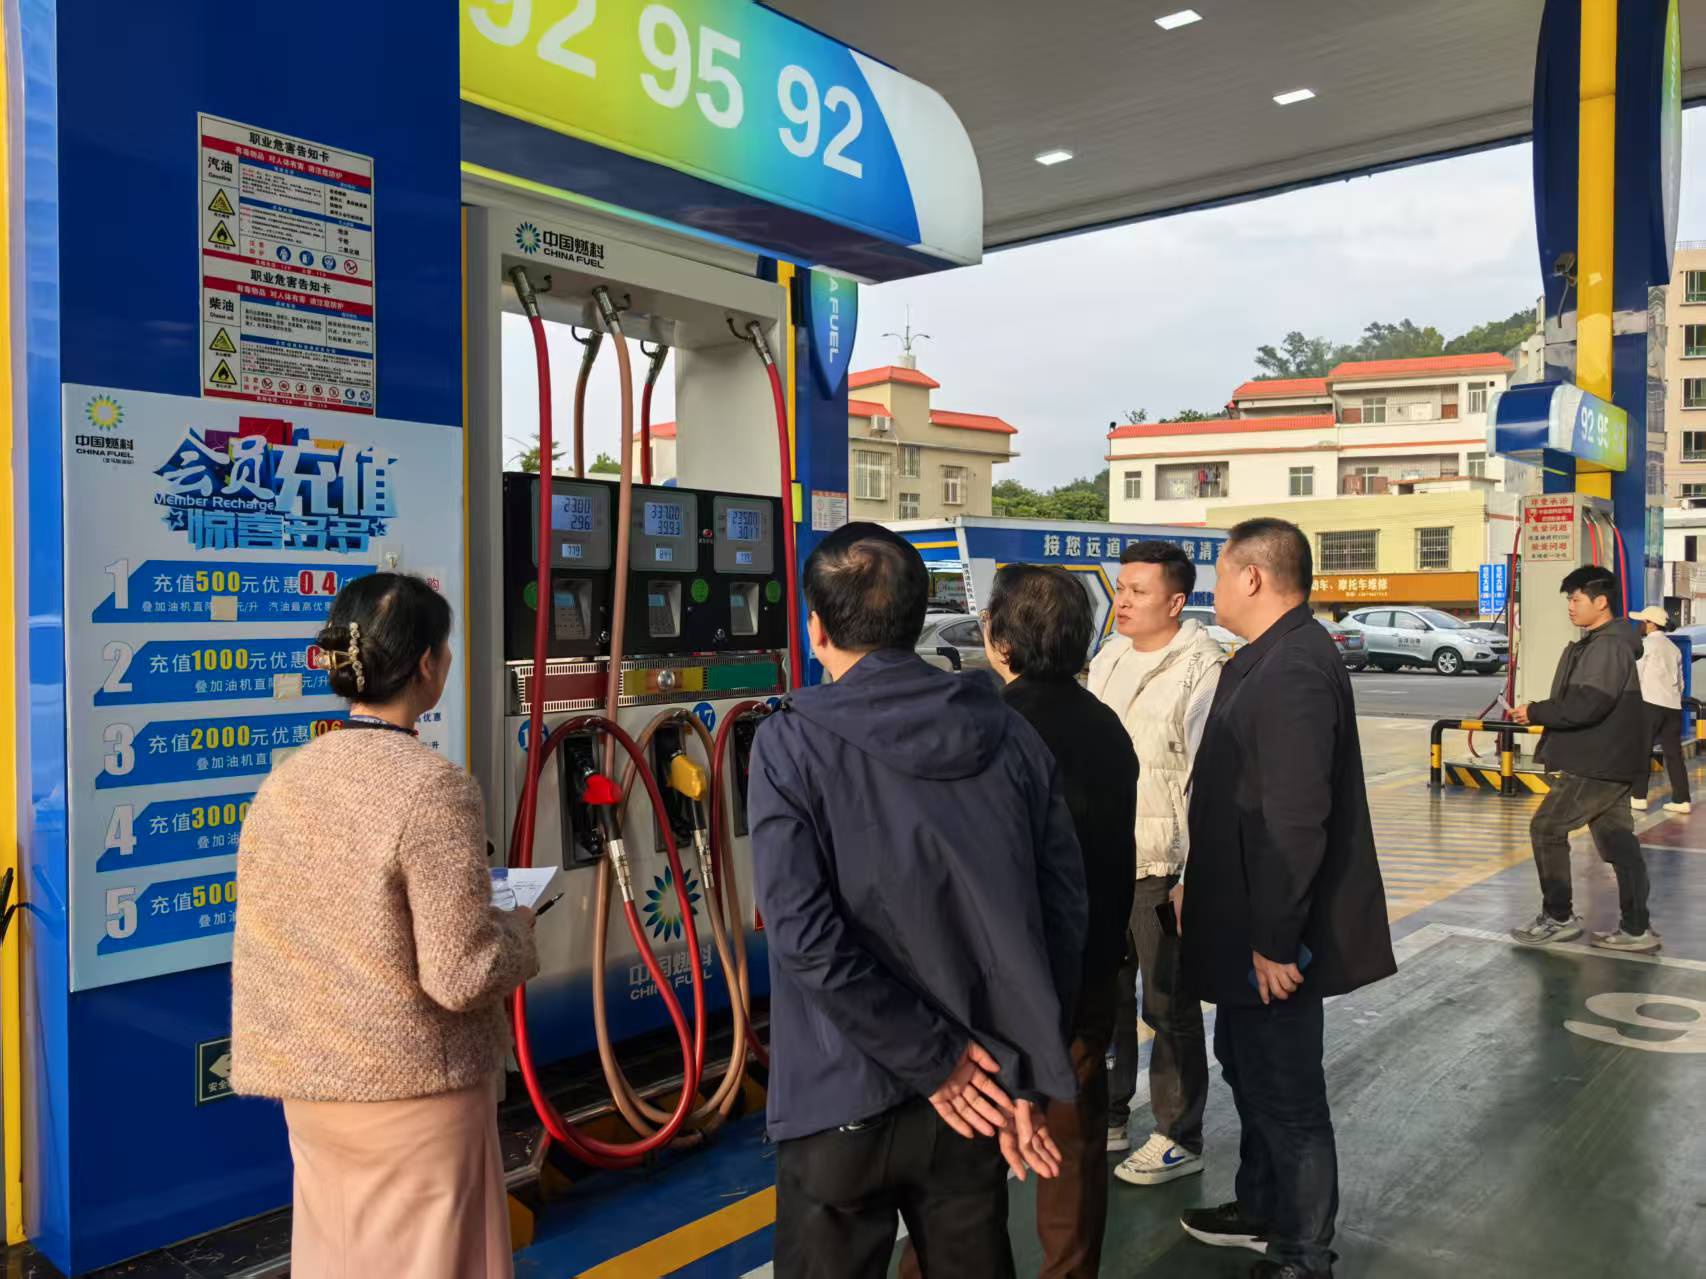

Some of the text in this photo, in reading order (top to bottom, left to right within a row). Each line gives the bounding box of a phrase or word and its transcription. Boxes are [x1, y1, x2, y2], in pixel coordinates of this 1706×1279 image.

[638, 4, 744, 129] 95
[777, 64, 863, 179] 92
[249, 131, 330, 163] 职业危害告知卡
[207, 156, 233, 174] 汽油
[543, 230, 604, 260] 中国燃料
[543, 247, 605, 269] CHINA FUEL
[250, 269, 332, 294] 职业危害告知卡
[209, 296, 235, 313] 柴油
[829, 296, 839, 364] FUEL
[75, 434, 134, 451] 中国燃料
[1581, 406, 1594, 444] 92
[1597, 413, 1609, 449] 95
[76, 448, 134, 459] CHINA FUEL
[153, 427, 399, 517] 会员充值
[153, 491, 275, 512] Member Recharge
[103, 559, 129, 610] 1
[103, 640, 133, 693] 2
[103, 722, 135, 776] 3
[196, 752, 272, 771] 叠加油机直
[104, 803, 137, 856] 4
[197, 832, 240, 849] 叠加油
[105, 887, 138, 940] 5
[150, 880, 238, 916] 充值500
[675, 969, 713, 988] FUL
